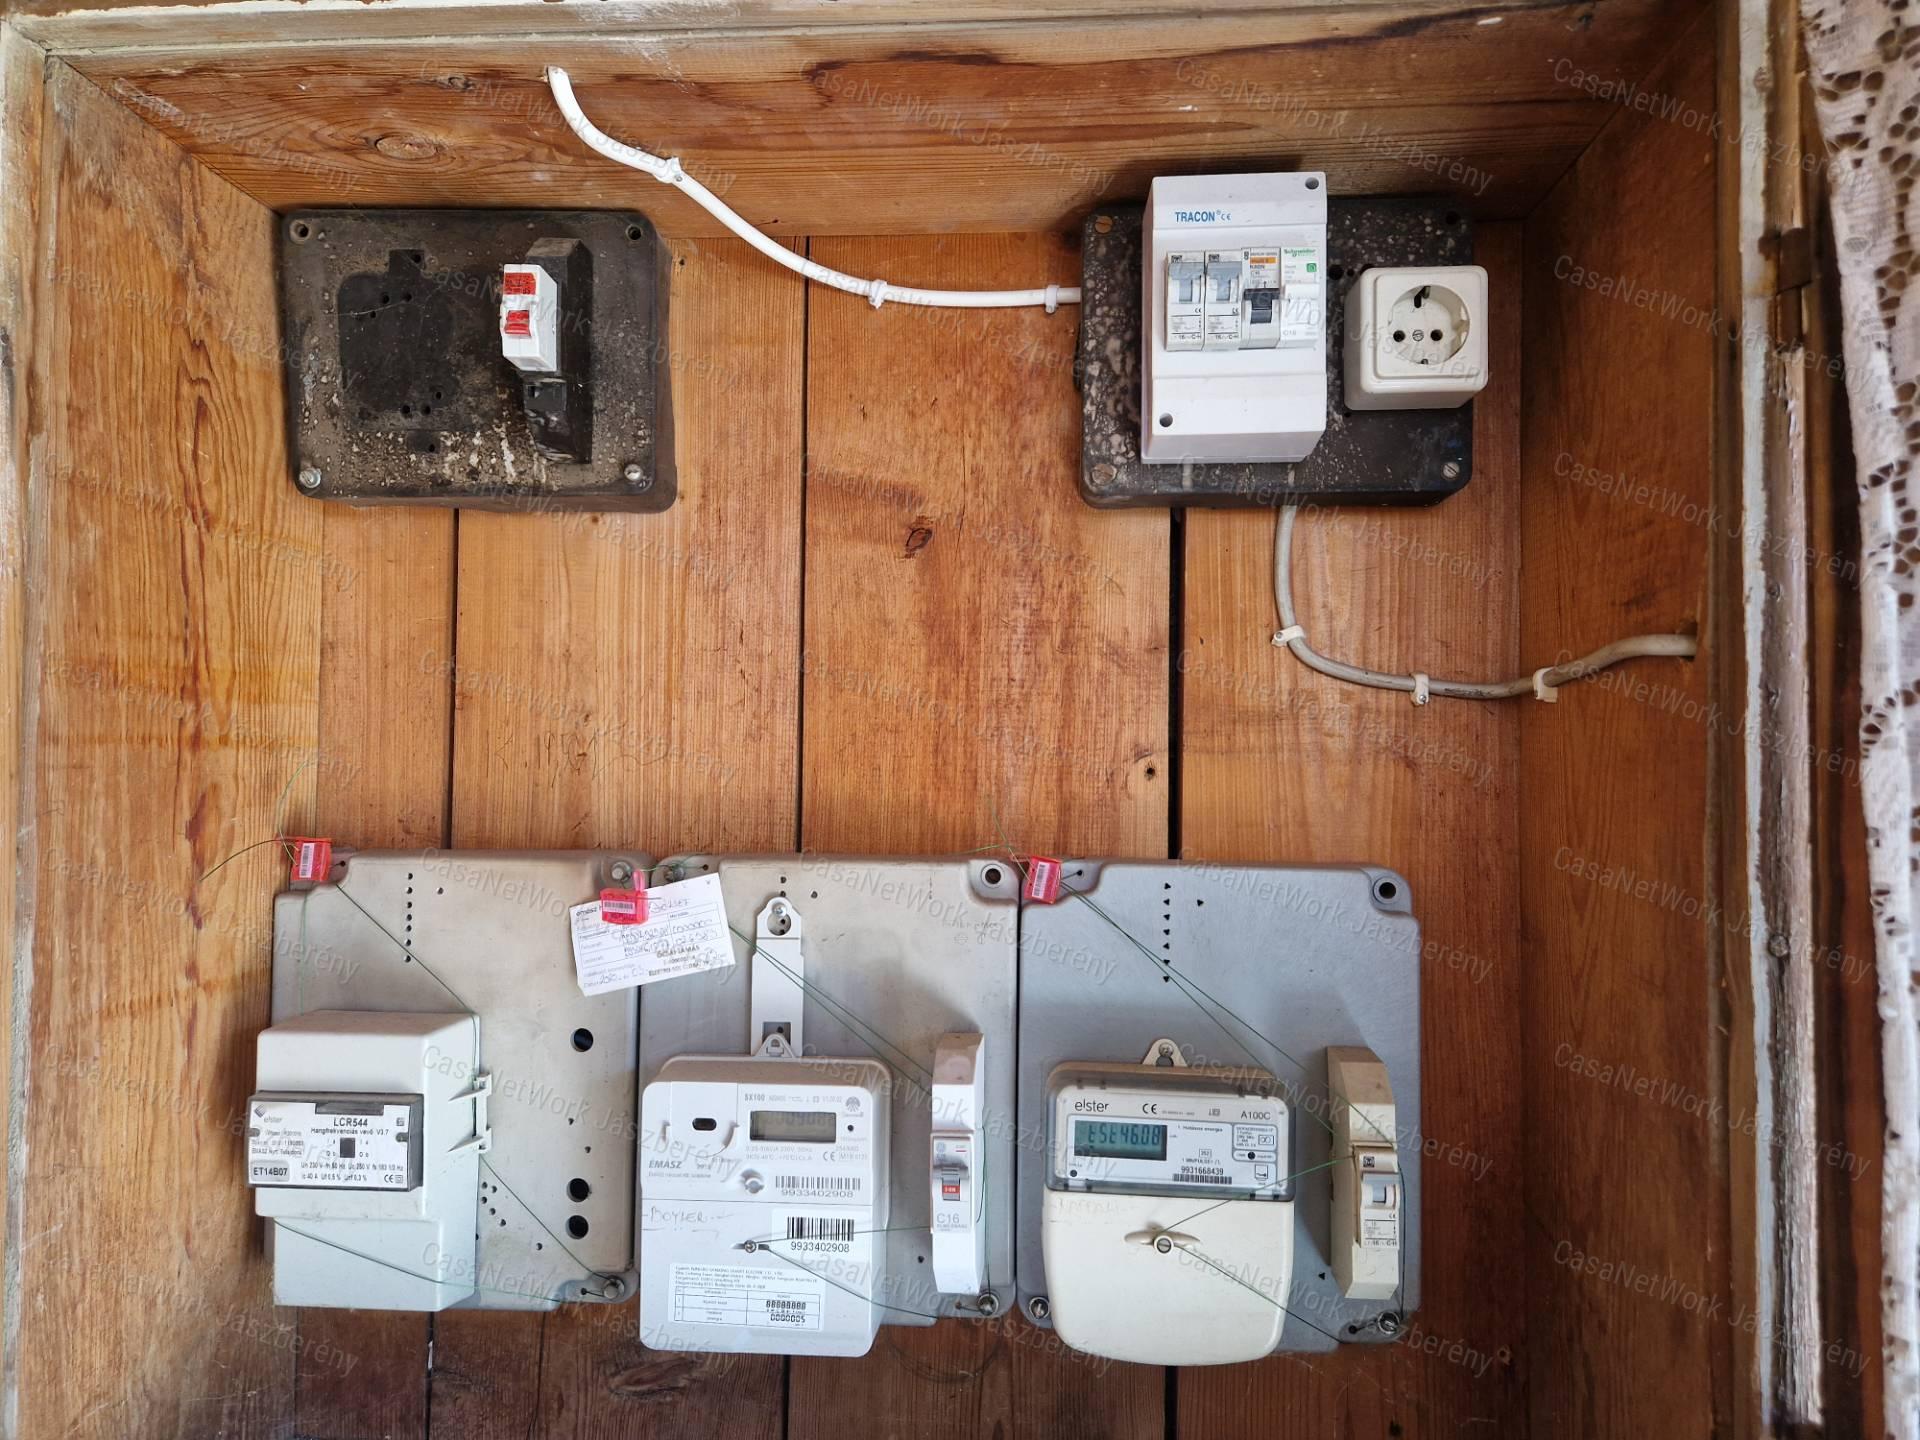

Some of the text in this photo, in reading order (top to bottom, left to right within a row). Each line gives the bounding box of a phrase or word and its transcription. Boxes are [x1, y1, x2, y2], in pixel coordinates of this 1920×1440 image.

[1074, 1098, 1110, 1113] elster
[1240, 1110, 1271, 1120] A100C
[333, 1118, 368, 1127] LCR544
[253, 1168, 288, 1176] ET14B07
[1181, 1165, 1224, 1175] 9931668439
[781, 1188, 854, 1198] 9933402908
[936, 1213, 960, 1224] C16
[791, 1242, 850, 1253] 9933402908
